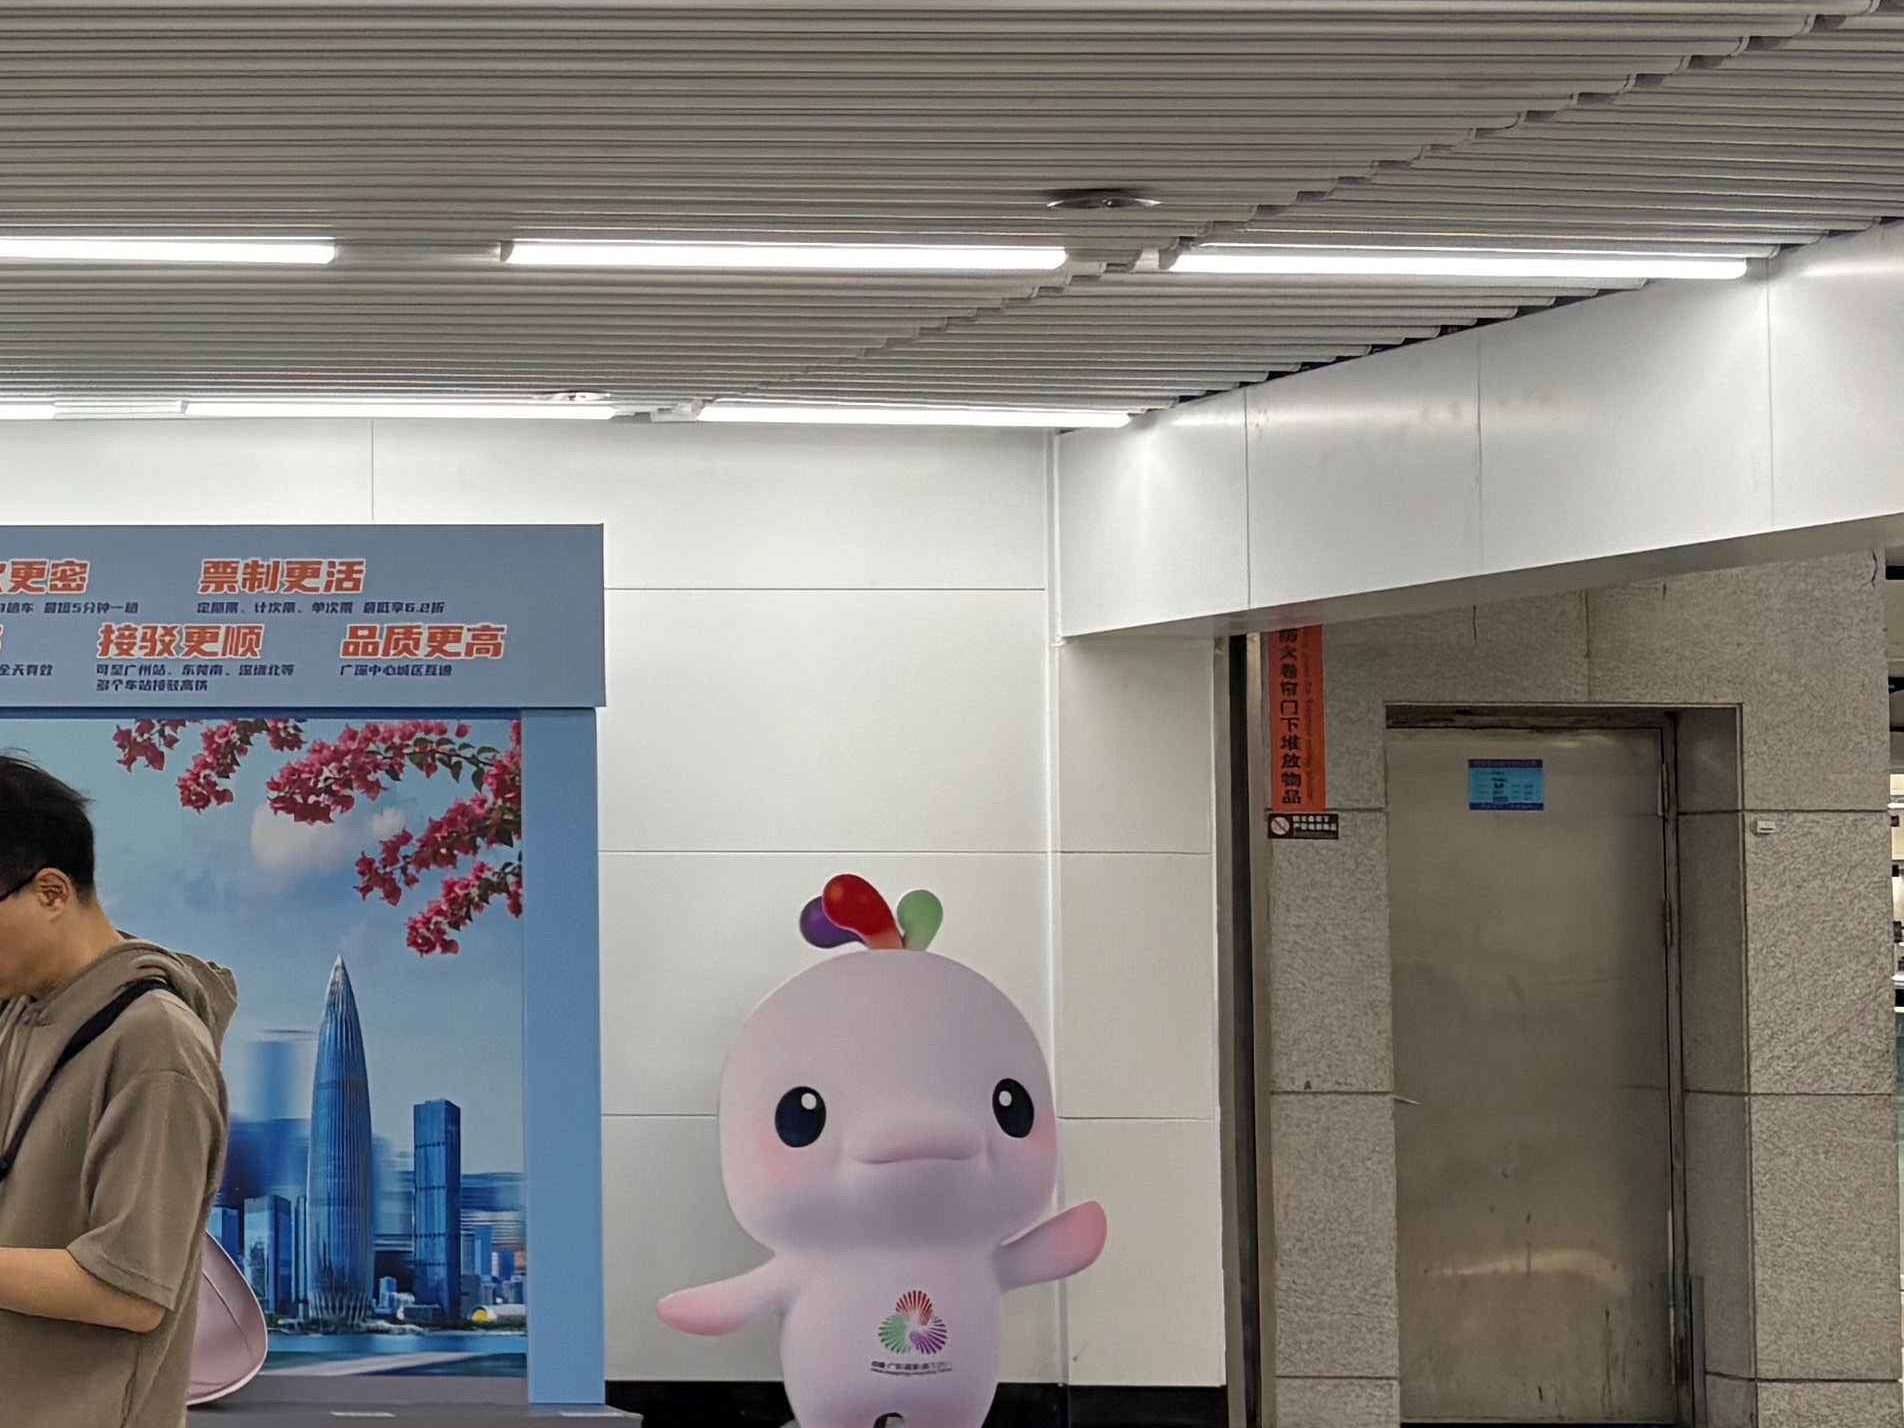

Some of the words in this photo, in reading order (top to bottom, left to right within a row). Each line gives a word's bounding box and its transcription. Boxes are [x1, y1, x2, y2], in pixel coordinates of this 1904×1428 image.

[197, 559, 365, 594] 票制更活
[96, 623, 264, 659] 接驳更顺
[340, 623, 507, 659] 品质更高
